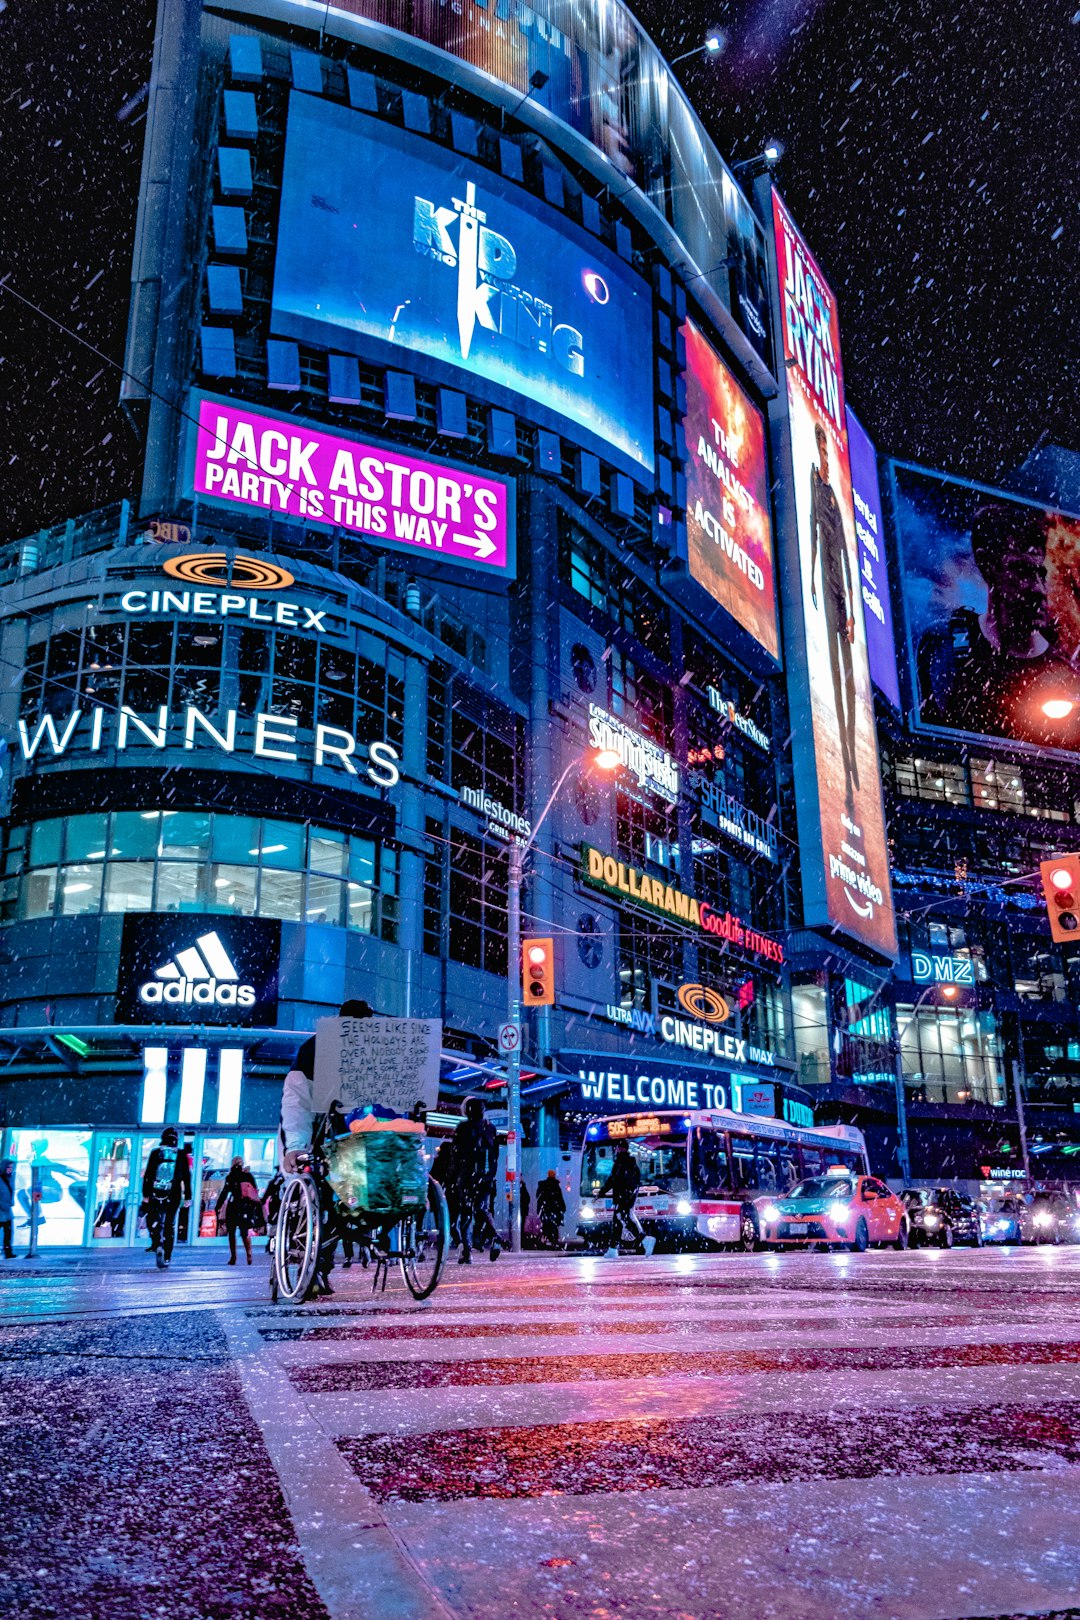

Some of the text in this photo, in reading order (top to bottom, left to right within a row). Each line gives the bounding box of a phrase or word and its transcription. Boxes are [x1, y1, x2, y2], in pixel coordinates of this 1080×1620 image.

[451, 197, 487, 224] THE
[778, 208, 795, 244] TOM
[784, 232, 836, 366] JACK
[784, 288, 842, 432] RYAN
[712, 418, 739, 468] THE
[206, 416, 499, 532] JACK ASTOR'S
[697, 435, 755, 518] ANALYST
[205, 462, 449, 548] PARTY IS THIS WAY
[722, 496, 737, 528] IS
[694, 500, 765, 591] ACTIVATED
[121, 589, 328, 633] CINEPLEX
[18, 704, 400, 788] WINNERS
[463, 785, 531, 837] milestones
[701, 777, 746, 831] SHARK
[747, 809, 778, 850] CLUB
[588, 848, 701, 926] DOLLARAMA
[829, 853, 883, 906] prime video
[700, 902, 784, 963] GoodLife FITNESS
[141, 976, 257, 1006] adidas
[911, 953, 973, 983] DMZ
[340, 1034, 361, 1047] THE
[341, 1020, 380, 1033] SEEMS
[385, 1022, 407, 1034] LIKE
[661, 1015, 747, 1064] CINEPLEX
[340, 1046, 367, 1058] OVER
[371, 1046, 406, 1057] NOBODY
[750, 1046, 775, 1066] IMAX
[579, 1070, 698, 1108] WELCOME
[702, 1083, 727, 1110] TO
[608, 1121, 626, 1139] 505
[990, 1166, 1026, 1179] wine rac
